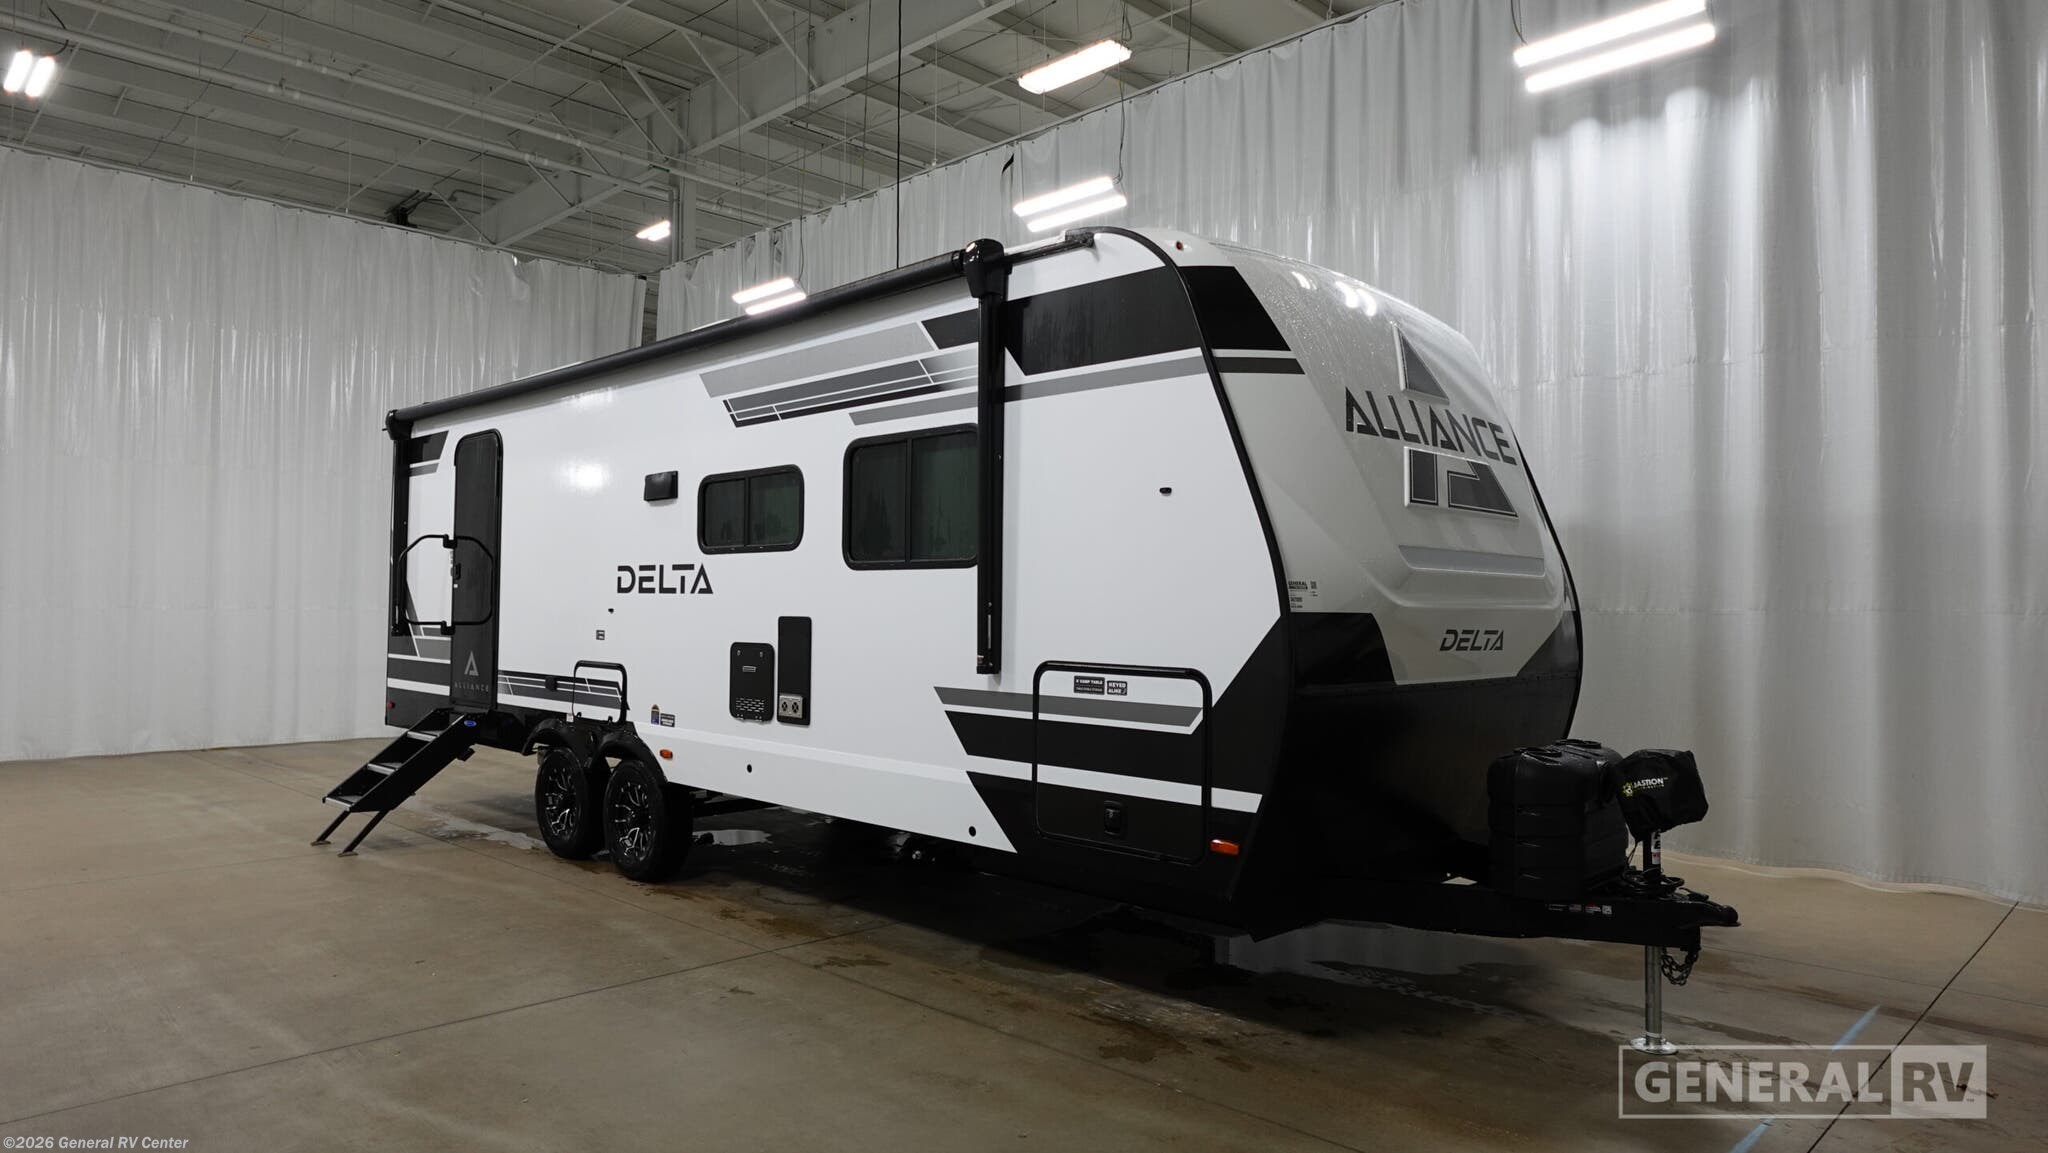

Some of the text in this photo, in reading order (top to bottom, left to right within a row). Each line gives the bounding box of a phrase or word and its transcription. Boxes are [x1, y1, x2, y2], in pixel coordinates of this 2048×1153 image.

[1345, 386, 1517, 466] ALLIANCE
[617, 563, 714, 594] DELTA
[1440, 629, 1504, 651] DELTA
